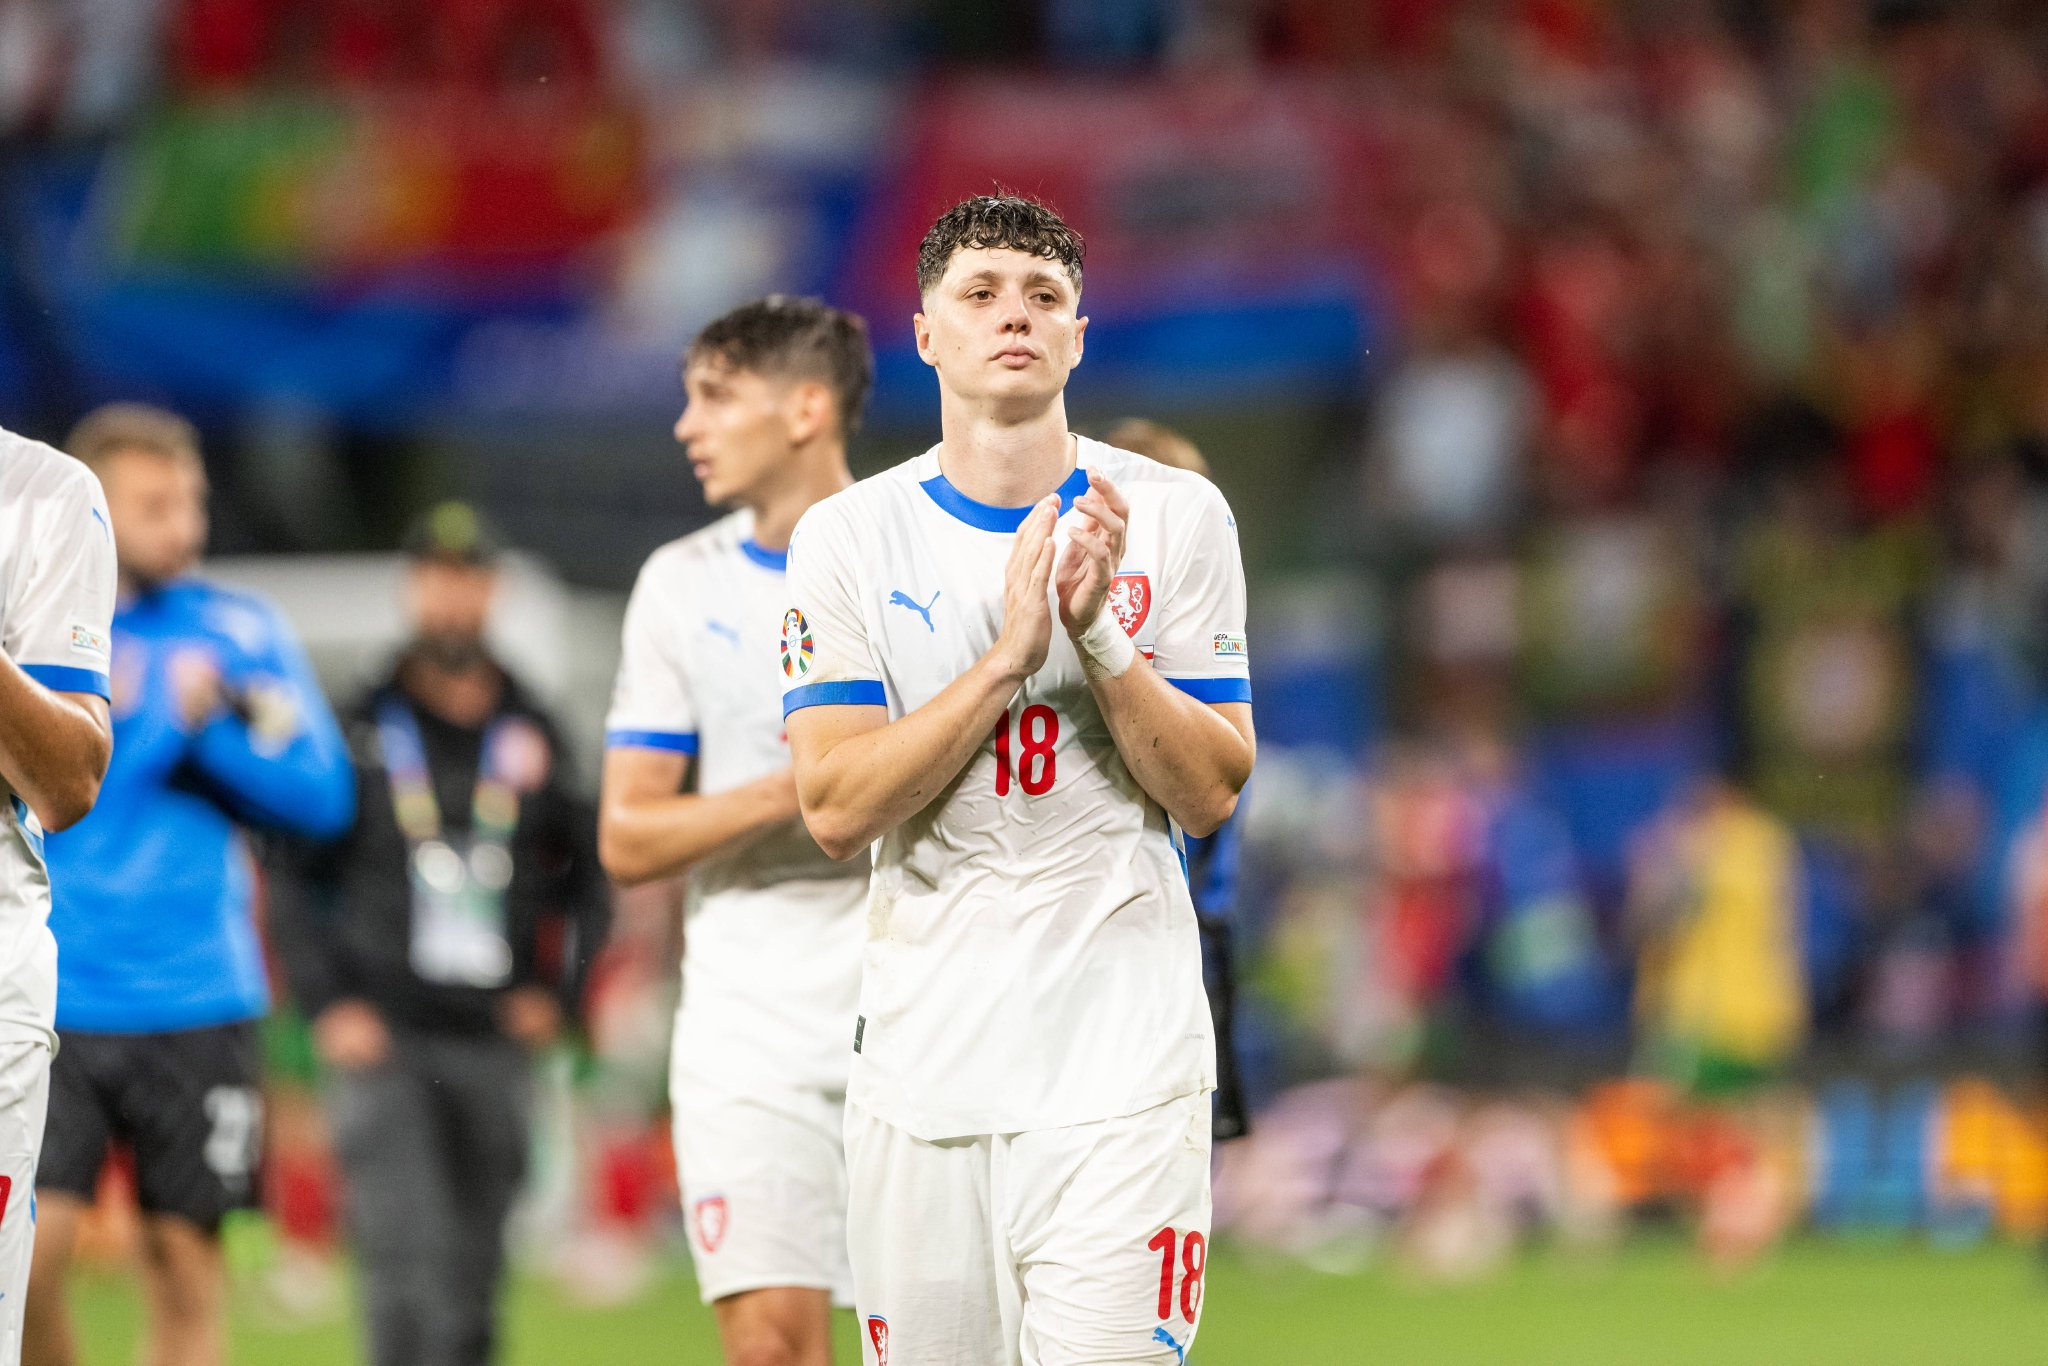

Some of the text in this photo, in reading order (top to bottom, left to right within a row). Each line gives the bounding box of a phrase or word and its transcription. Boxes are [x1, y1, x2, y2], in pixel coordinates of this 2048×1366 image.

[1214, 633, 1228, 641] UEFA
[995, 704, 1059, 796] 18
[1148, 1227, 1205, 1324] 18
